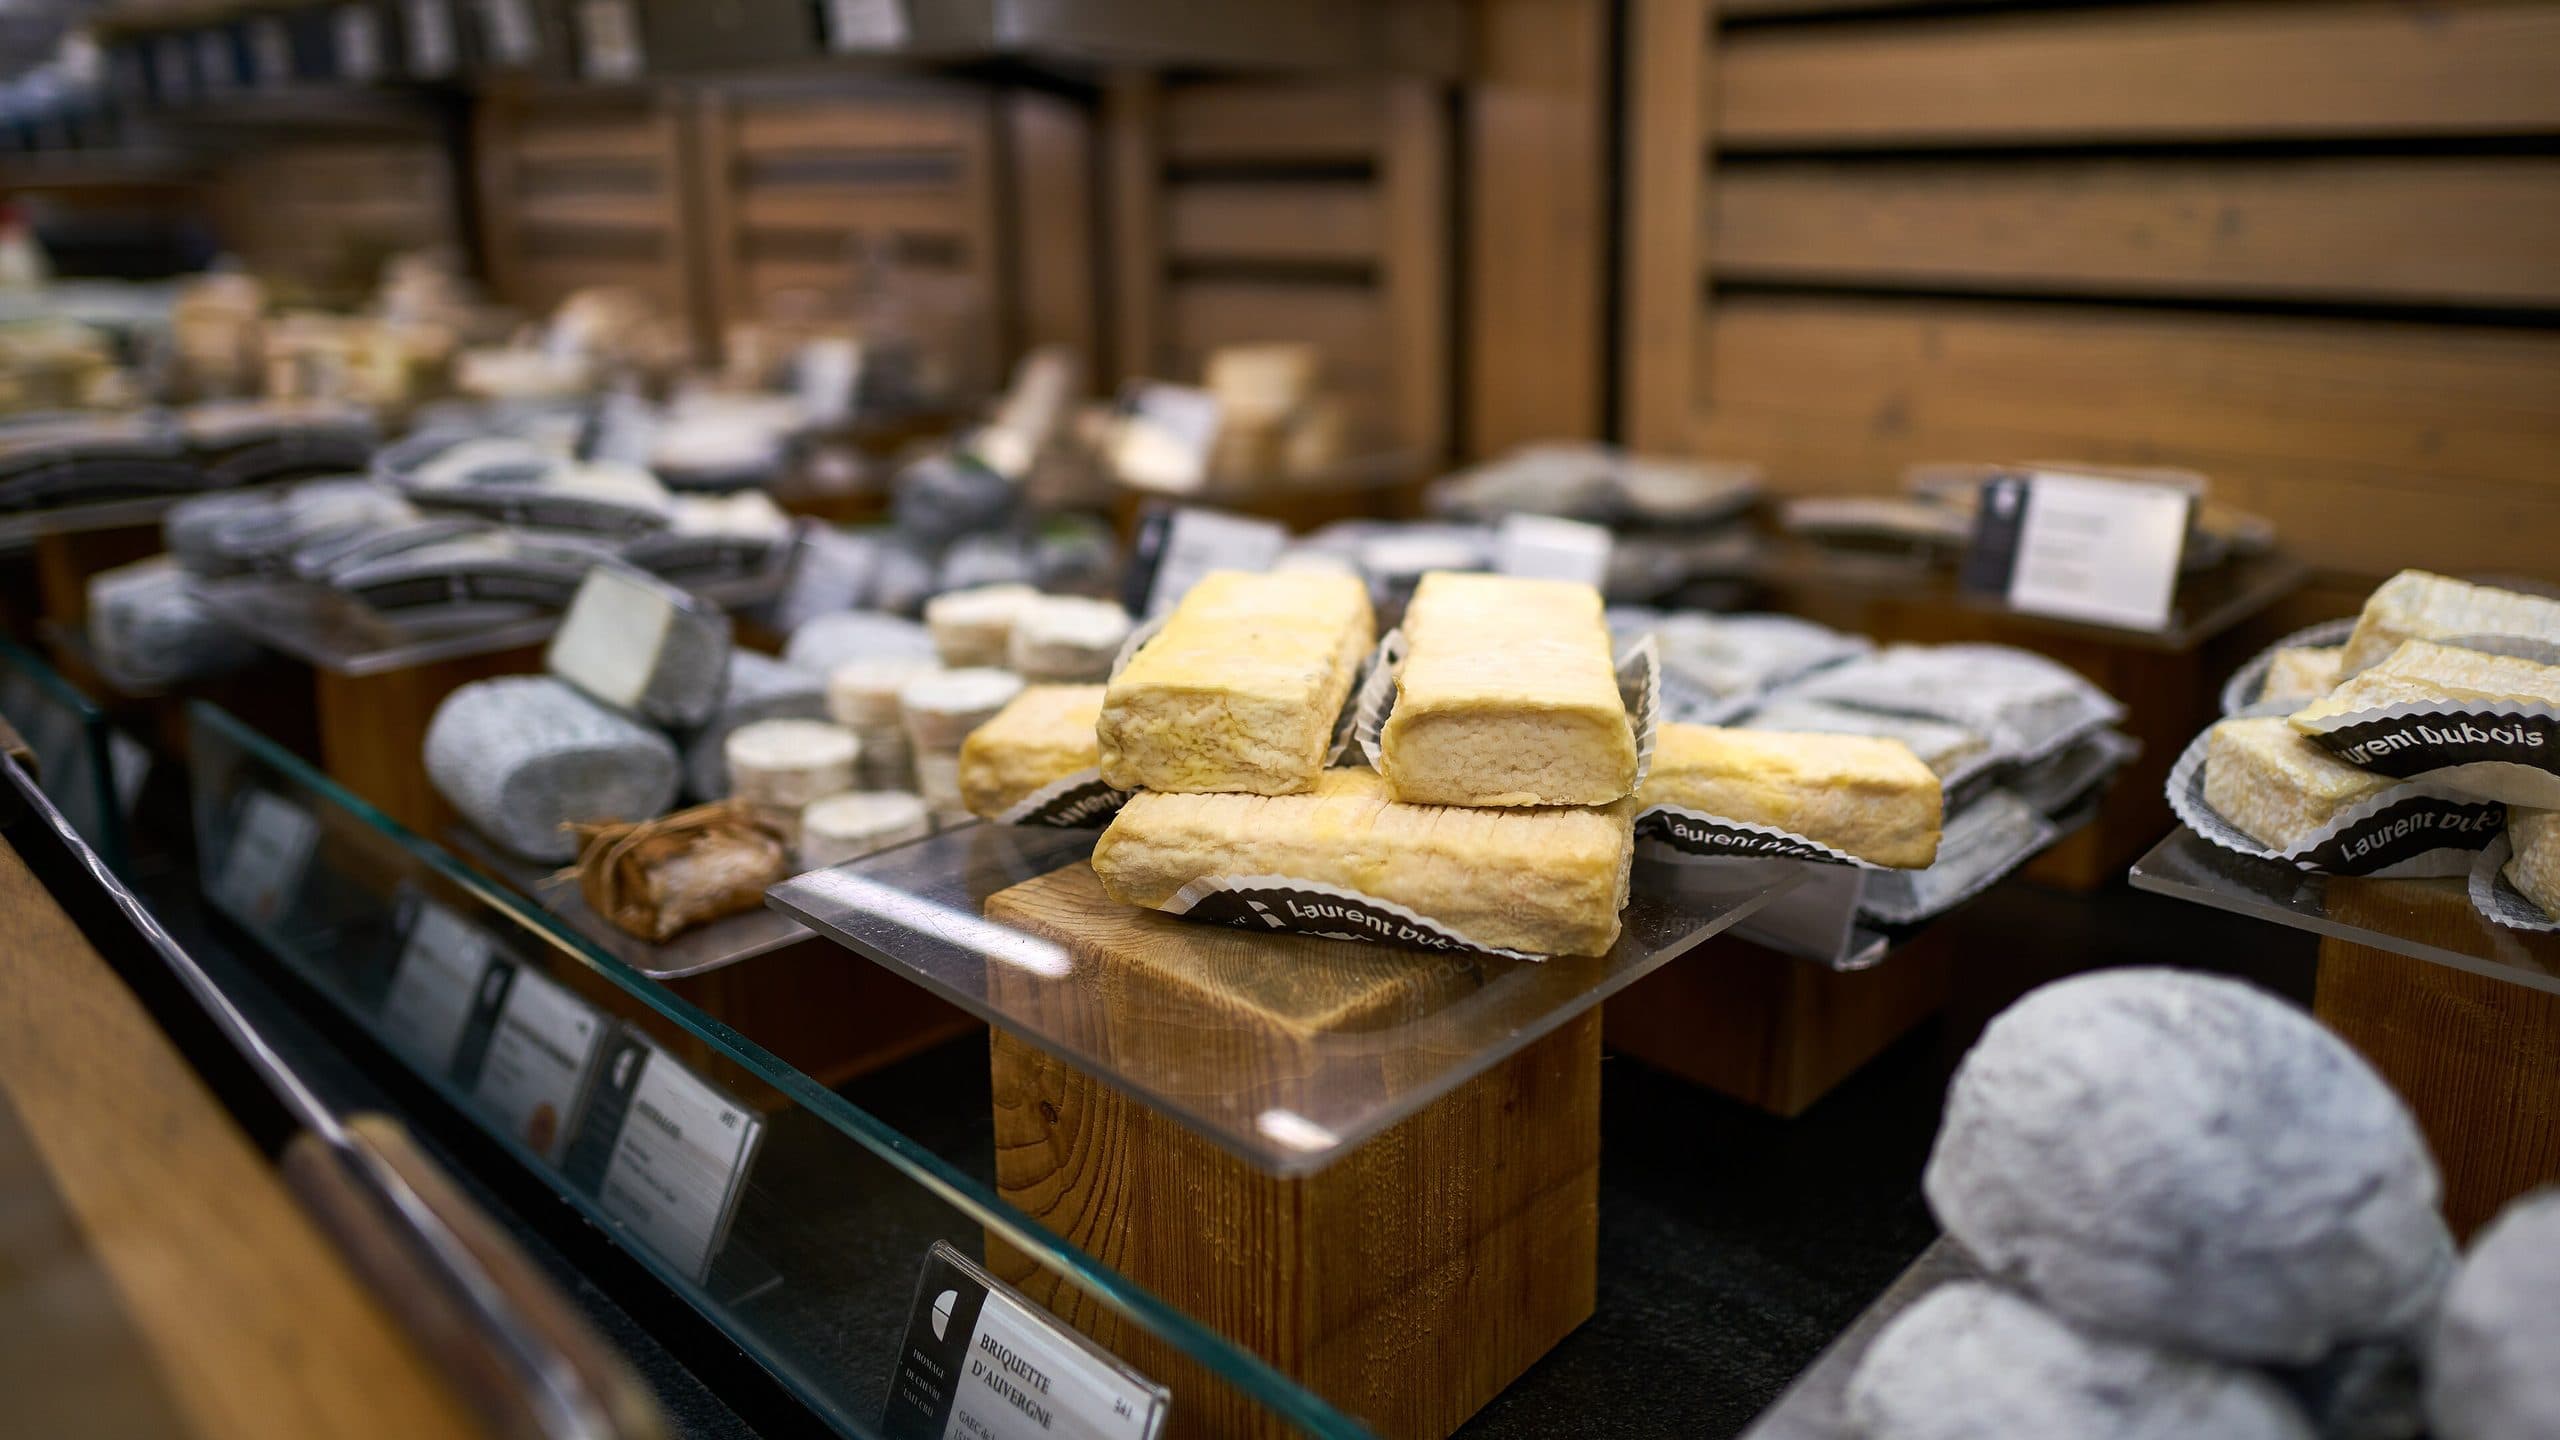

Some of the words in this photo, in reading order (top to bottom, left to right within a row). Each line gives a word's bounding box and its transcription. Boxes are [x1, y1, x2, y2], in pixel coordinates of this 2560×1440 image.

[2345, 728, 2421, 765] urent
[2417, 722, 2544, 746] Dubois
[2340, 811, 2436, 863] Laurent
[1286, 899, 1393, 936] Laurent
[980, 1334, 1052, 1395] BRIQUETTE
[971, 1359, 1054, 1431] D'AUVERGNE
[958, 1410, 981, 1434] GAEC
